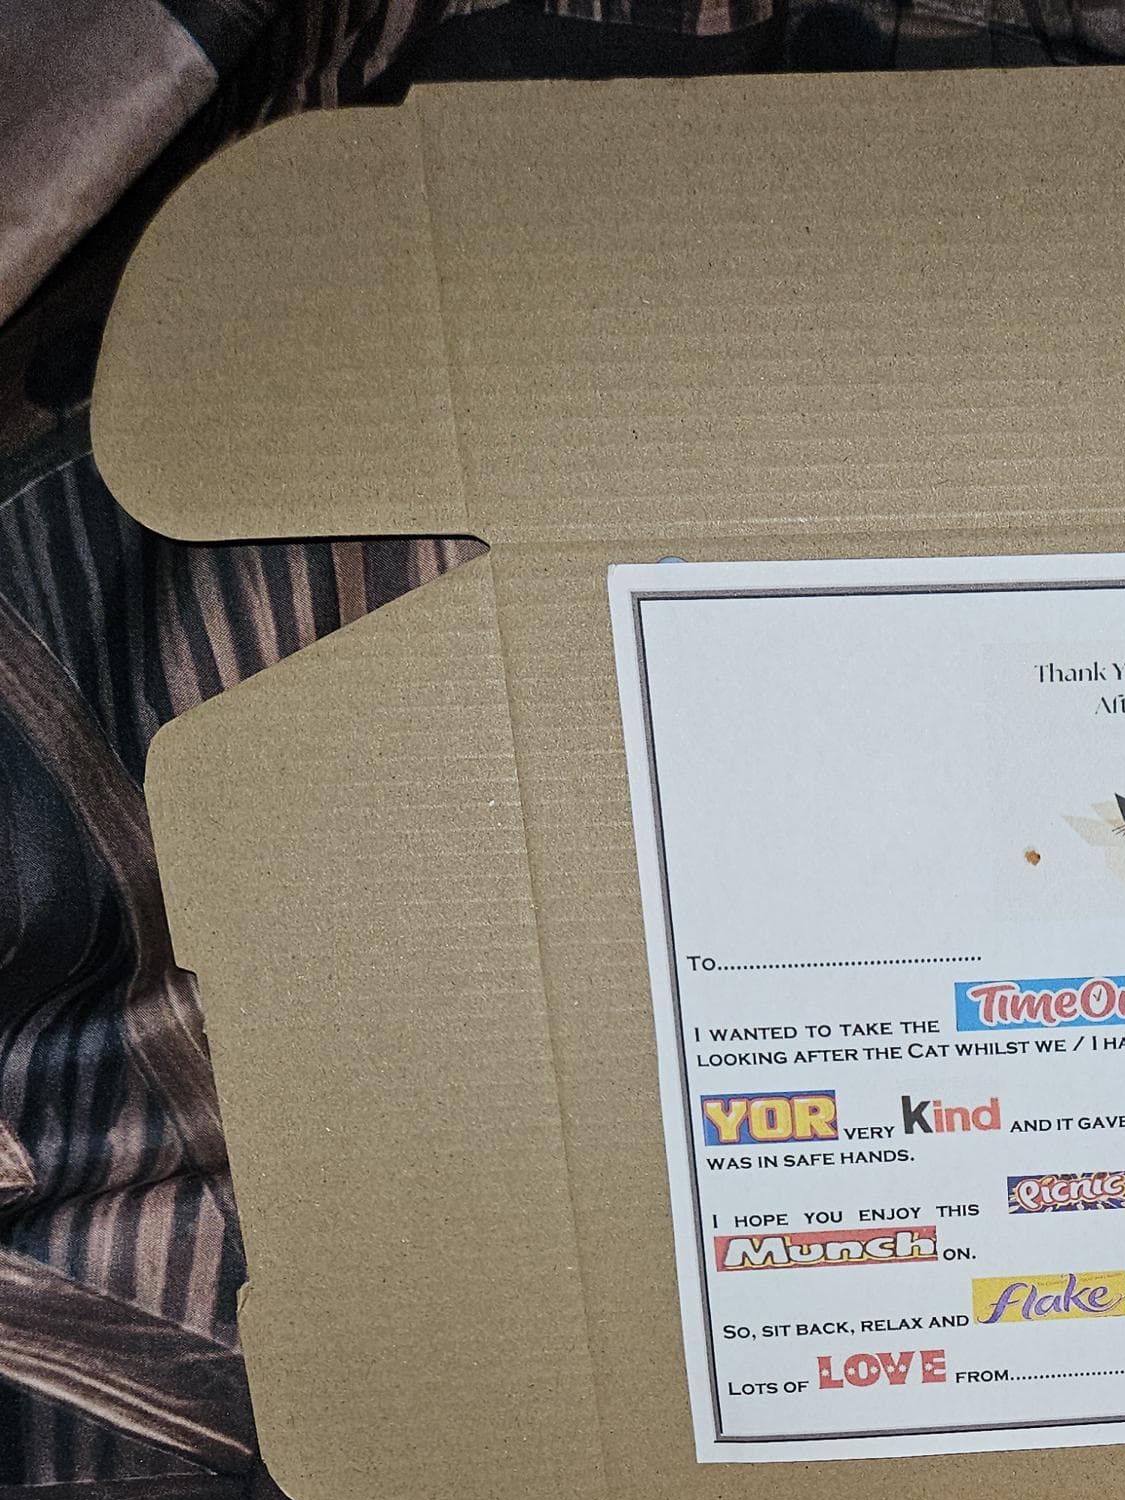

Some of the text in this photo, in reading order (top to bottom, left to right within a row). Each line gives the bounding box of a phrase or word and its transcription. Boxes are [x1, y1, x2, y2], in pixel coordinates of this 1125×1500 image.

[1034, 662, 1106, 682] Thank
[695, 1028, 700, 1042] I
[710, 1027, 797, 1041] WANTED
[805, 1025, 831, 1038] TO
[840, 1022, 892, 1036] TAKE
[900, 1021, 940, 1034] THE
[698, 1052, 787, 1066] LOOKING
[794, 1049, 858, 1063] AFTER
[863, 1047, 902, 1060] THE
[955, 1041, 1029, 1056] WHILST
[1035, 1040, 1066, 1052] WE
[1073, 1036, 1084, 1051] /
[1092, 1036, 1096, 1050] I
[704, 1096, 836, 1143] YOR
[844, 1126, 894, 1140] VERY
[902, 1095, 1001, 1134] Kind
[1010, 1120, 1052, 1132] AND
[1057, 1118, 1073, 1130] IT
[706, 1150, 914, 1170] WAS IN SAFE HANDS.
[713, 1215, 717, 1228] I
[735, 1214, 788, 1227] HOPE
[804, 1211, 842, 1224] YOU
[859, 1208, 920, 1221] ENJOY
[936, 1204, 979, 1217] THIS
[723, 1231, 976, 1269] Munch ON.
[724, 1325, 756, 1340] SO,
[762, 1325, 790, 1337] SIT
[796, 1322, 854, 1336] BACK,
[861, 1318, 922, 1332] RELAX
[929, 1316, 969, 1328] AND
[728, 1382, 778, 1395] LOTS
[784, 1381, 808, 1393] OF
[817, 1349, 946, 1389] LOVE
